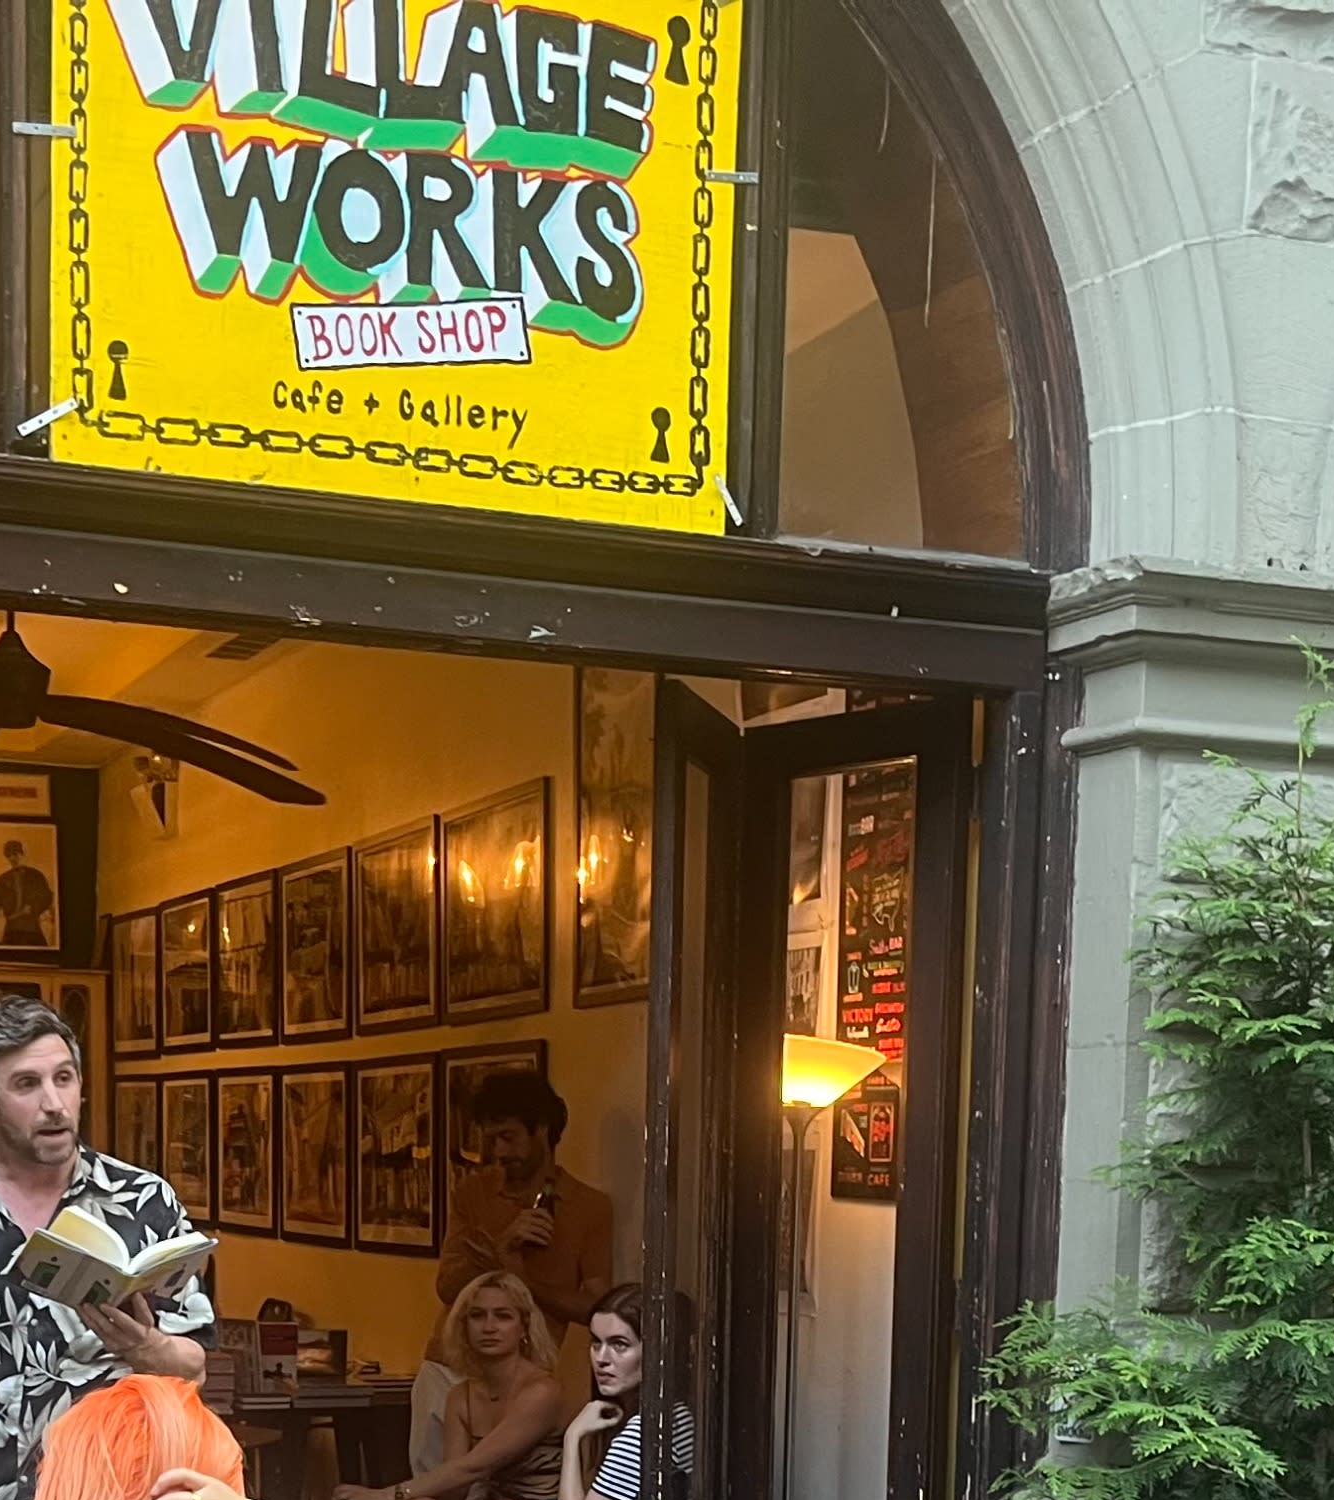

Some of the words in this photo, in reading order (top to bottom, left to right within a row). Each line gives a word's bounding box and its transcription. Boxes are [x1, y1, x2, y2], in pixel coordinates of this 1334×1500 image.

[117, 0, 658, 170] VILLAGE
[171, 125, 644, 338] WORKS
[305, 311, 403, 362] BOOK
[416, 305, 508, 354] SHOP
[272, 379, 344, 415] Cafe
[398, 388, 528, 450] Gallery
